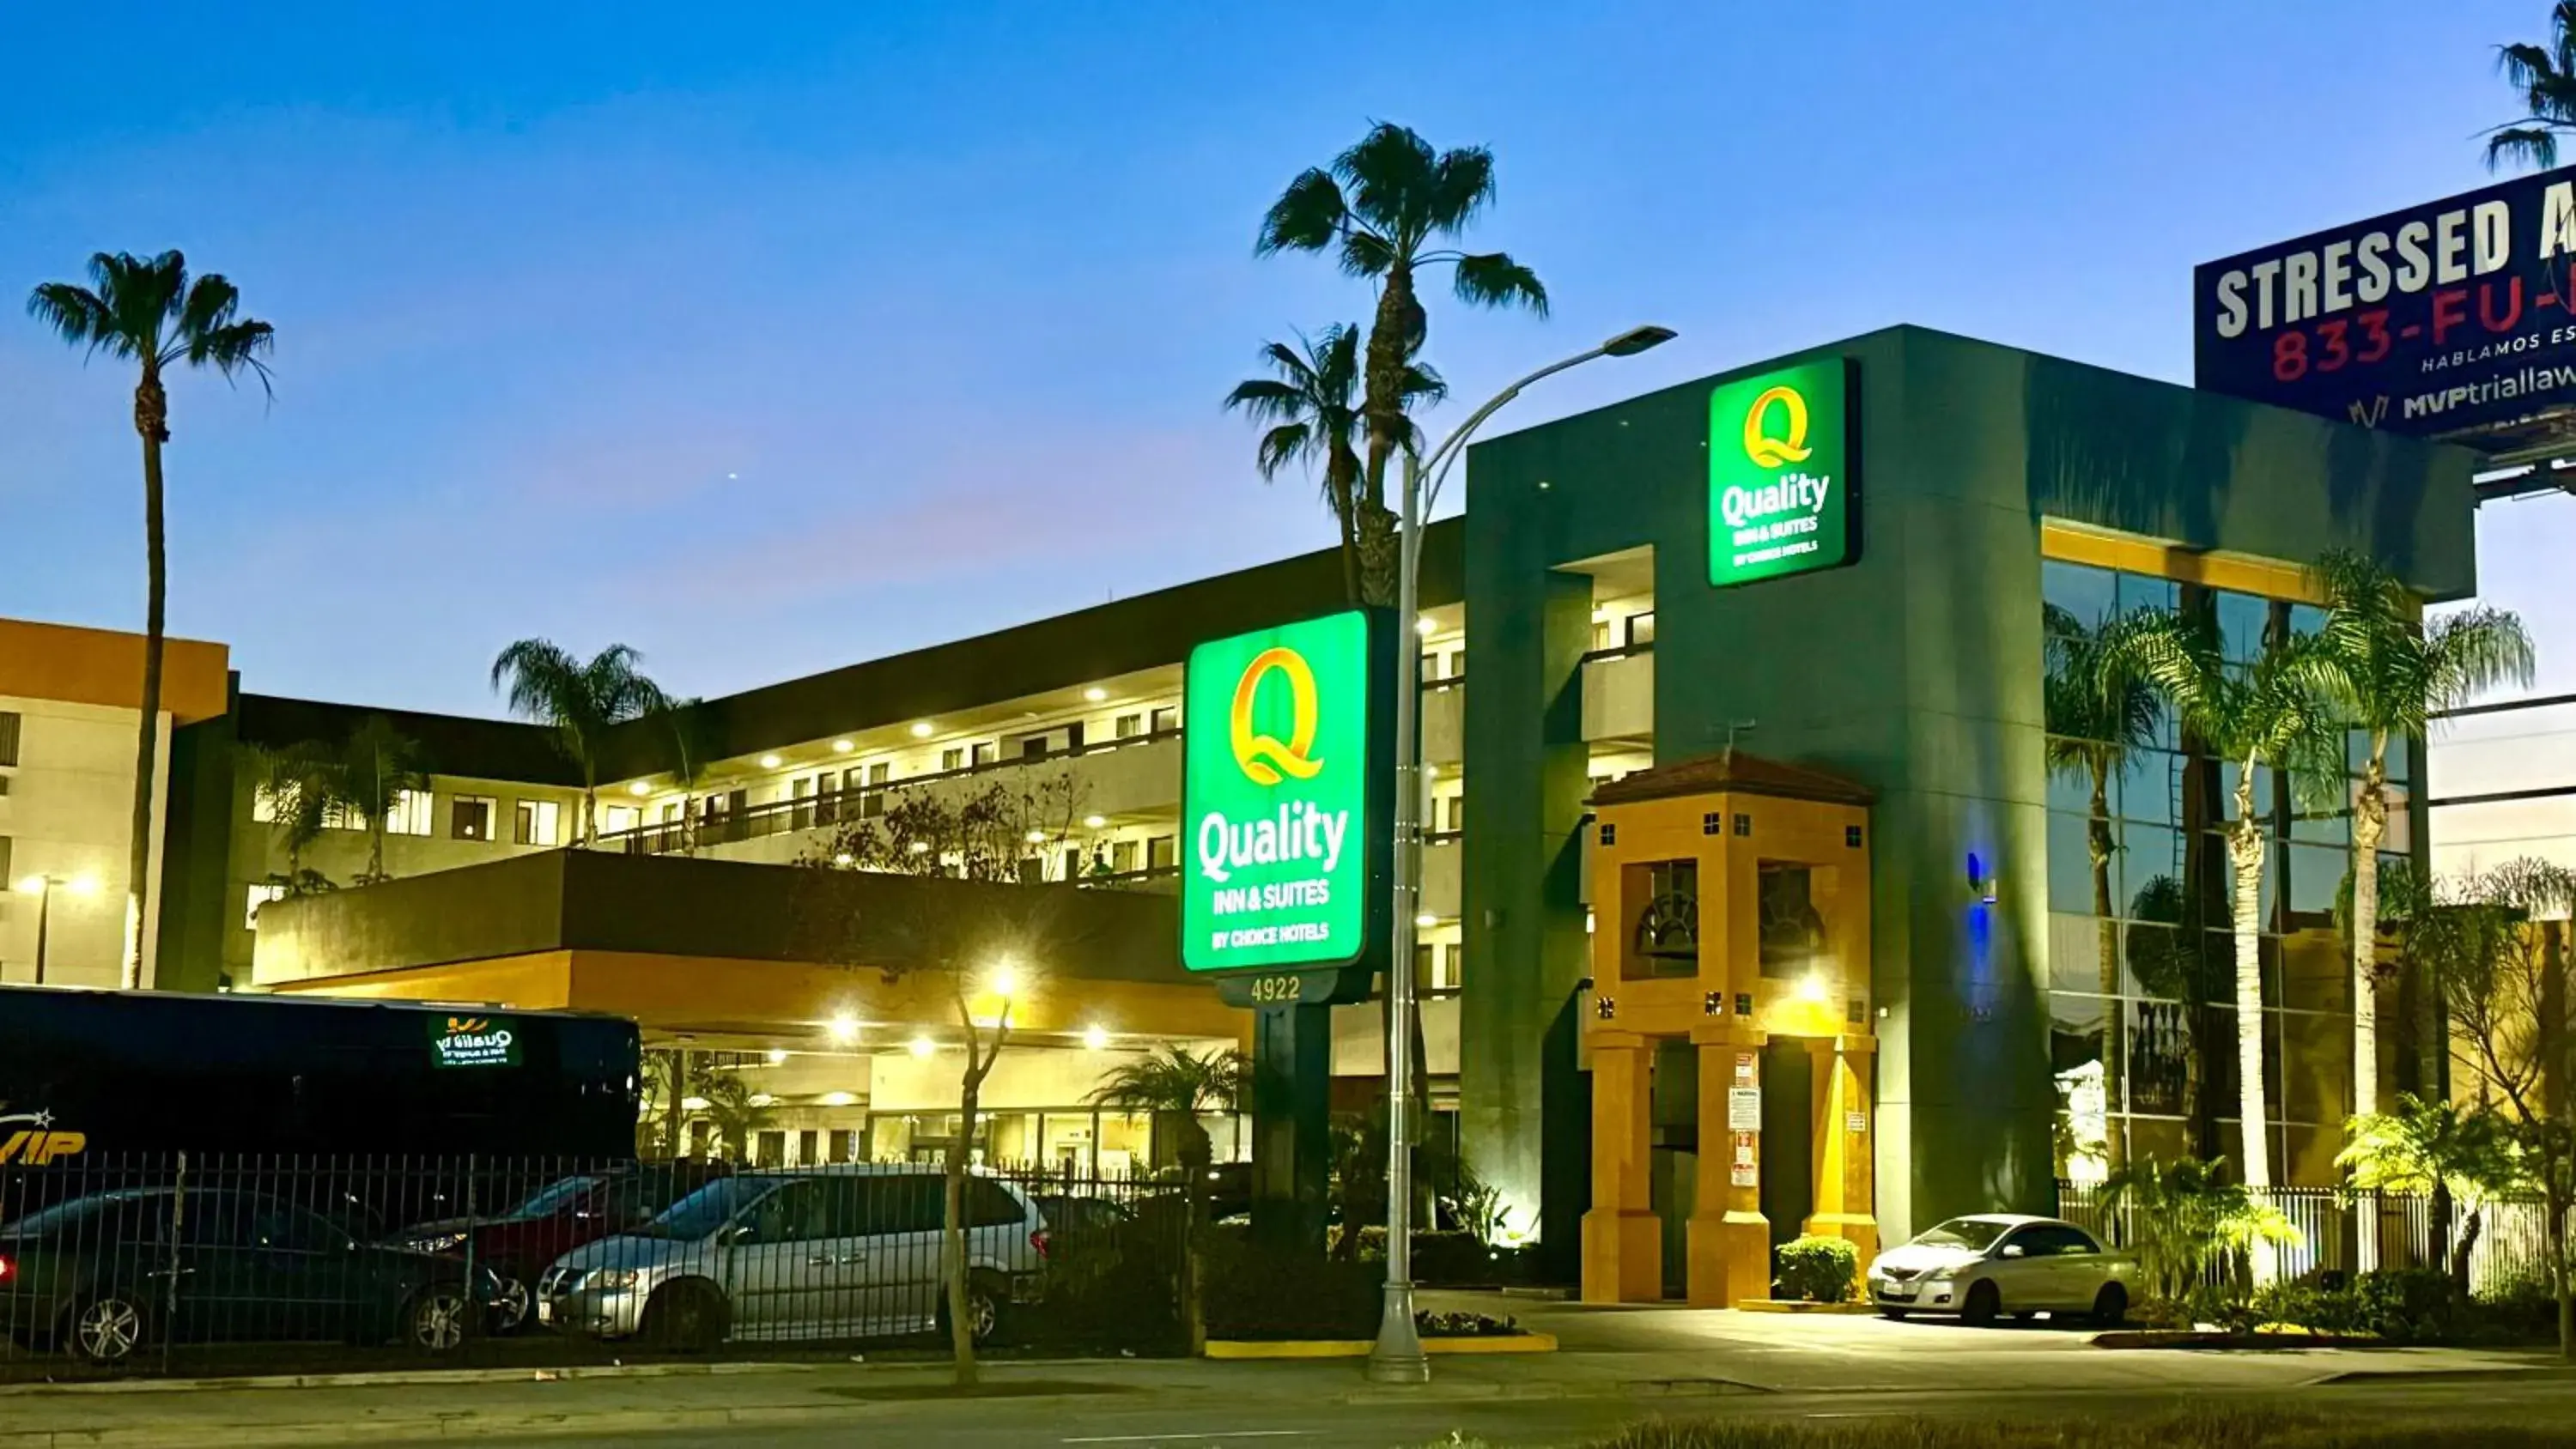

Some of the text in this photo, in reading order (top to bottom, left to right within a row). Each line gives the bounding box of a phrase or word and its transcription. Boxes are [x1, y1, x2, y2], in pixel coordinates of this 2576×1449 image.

[2216, 199, 2510, 338] STRESSED
[2421, 333, 2539, 373] HABLAMOS
[1744, 385, 1813, 468] Q
[1722, 473, 1830, 527] Quality
[1770, 516, 1818, 538] SUITES
[1230, 647, 1324, 785] Q
[1198, 800, 1348, 882] Quality
[1213, 879, 1330, 915] INN & SUITES
[1212, 922, 1329, 950] BY CHOICE HOTELS
[1251, 976, 1300, 1001] 4922
